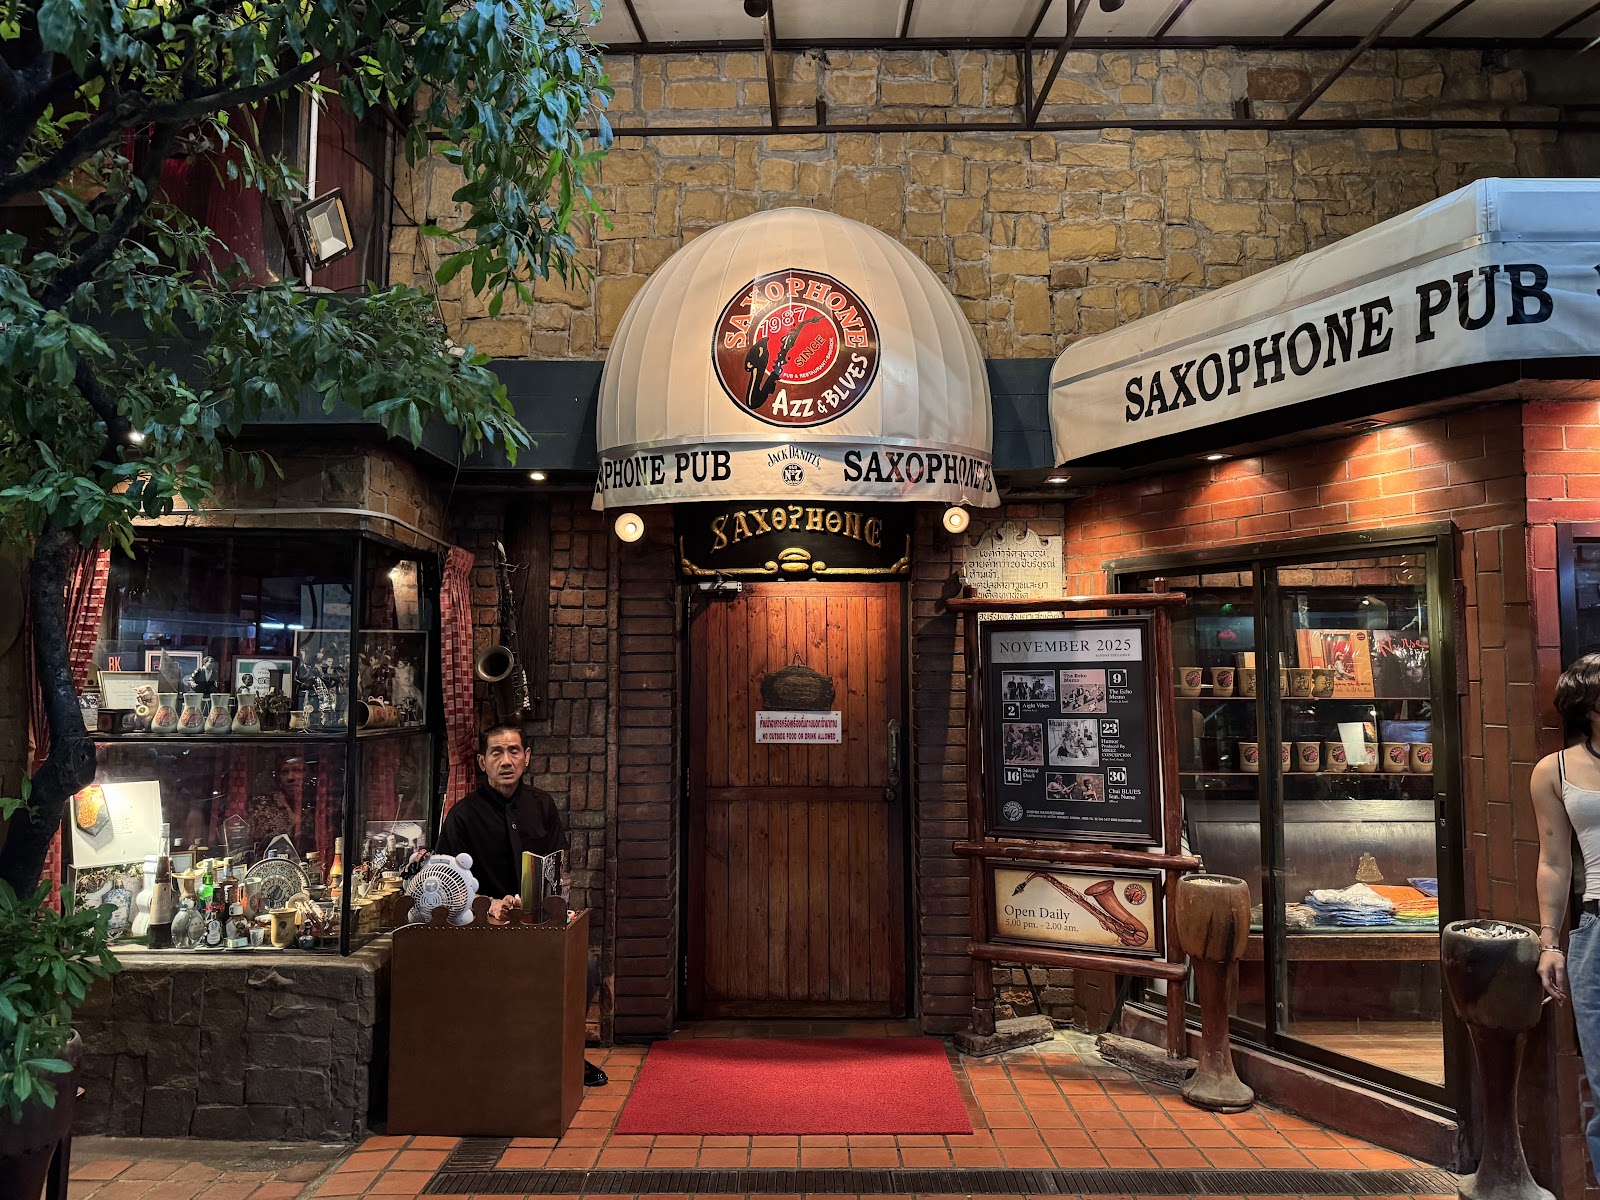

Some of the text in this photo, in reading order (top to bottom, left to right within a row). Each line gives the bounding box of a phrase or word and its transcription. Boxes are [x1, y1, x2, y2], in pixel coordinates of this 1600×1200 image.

[724, 278, 869, 349] SAXOPHONE
[760, 306, 808, 338] 1987
[794, 334, 826, 368] SINCE
[1124, 262, 1554, 423] SAXOPHONE PUB
[816, 399, 828, 415] &
[674, 450, 732, 484] PUB
[767, 448, 788, 468] JACK
[843, 450, 982, 489] SAXOPHONE
[710, 504, 883, 554] SAXOPHONE
[999, 638, 1132, 653] NOVEMBER 2025
[1377, 635, 1430, 657] Nurse
[108, 656, 122, 671] BK
[1112, 673, 1122, 684] 9
[1007, 705, 1016, 716] 2
[762, 732, 836, 740] NO OUTSIDE FOOD OR DRINK ALLOWED
[1102, 723, 1118, 734] 23
[1006, 771, 1020, 782] 16
[1109, 770, 1126, 781] 30
[1004, 904, 1071, 924] Open Daily
[1005, 918, 1021, 927] 5.00
[1023, 921, 1039, 930] pm.
[1045, 922, 1062, 931] 2.00
[1063, 924, 1079, 932] am.
